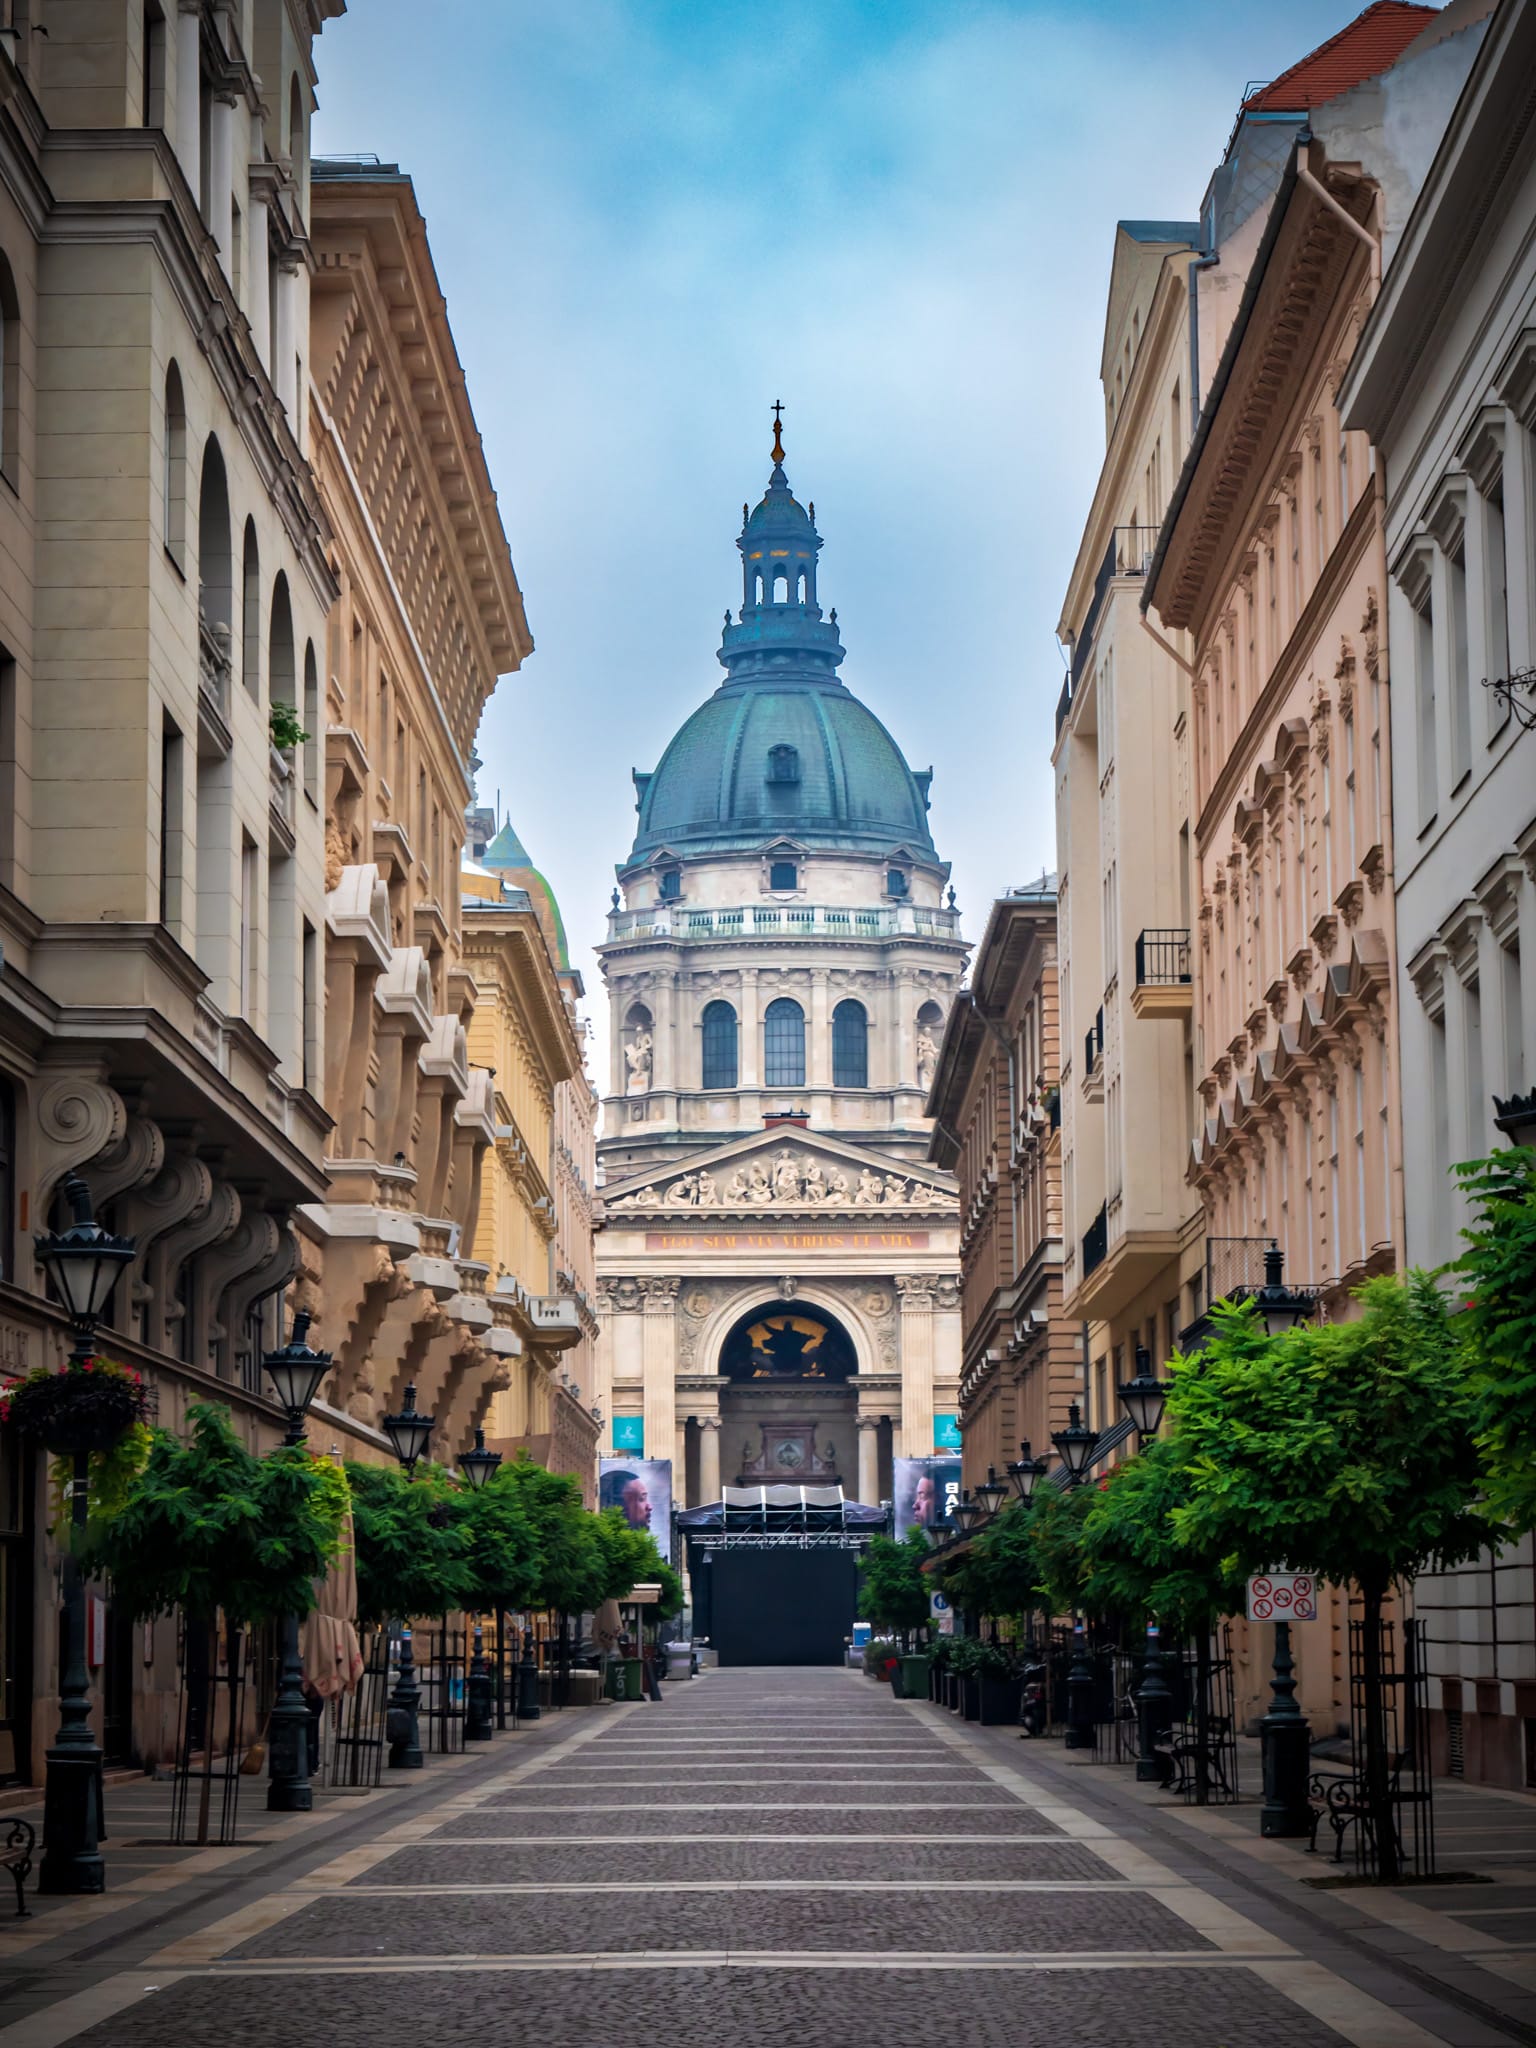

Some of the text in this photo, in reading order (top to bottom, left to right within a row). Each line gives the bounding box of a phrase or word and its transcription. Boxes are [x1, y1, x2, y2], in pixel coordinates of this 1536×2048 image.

[661, 1236, 693, 1249] EGO
[703, 1236, 736, 1248] SUM
[748, 1235, 773, 1248] VIA
[783, 1235, 844, 1248] VERITAS
[880, 1235, 912, 1247] VITA
